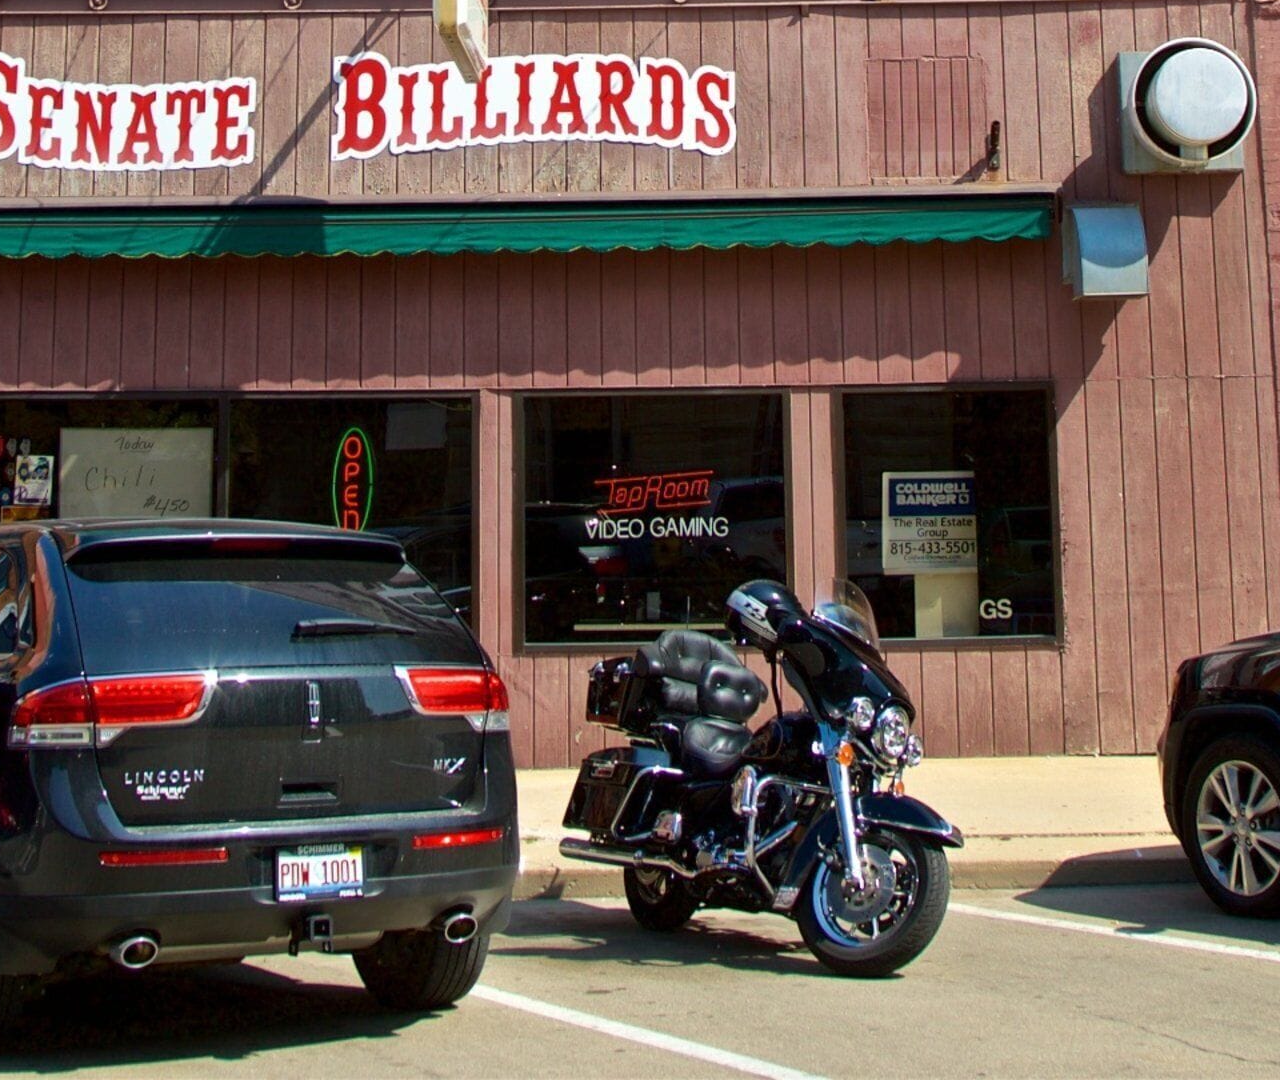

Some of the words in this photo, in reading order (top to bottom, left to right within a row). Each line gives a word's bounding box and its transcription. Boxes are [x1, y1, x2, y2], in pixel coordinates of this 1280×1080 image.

[337, 58, 731, 154] BILLIARDS
[115, 436, 155, 452] Today
[85, 465, 158, 491] Chili
[895, 482, 969, 494] COLDWELL
[896, 493, 957, 506] BANKER
[585, 519, 645, 539] VIDEO
[649, 516, 729, 538] GAMING
[893, 519, 912, 527] The
[915, 518, 937, 527] Real
[940, 517, 973, 527] Estate
[917, 528, 949, 539] Group
[890, 541, 976, 555] 815-433-5501
[124, 769, 204, 785] LINCOLN
[297, 843, 345, 854] SCHIMMER
[280, 862, 310, 889] PDW
[321, 858, 360, 885] 1001
